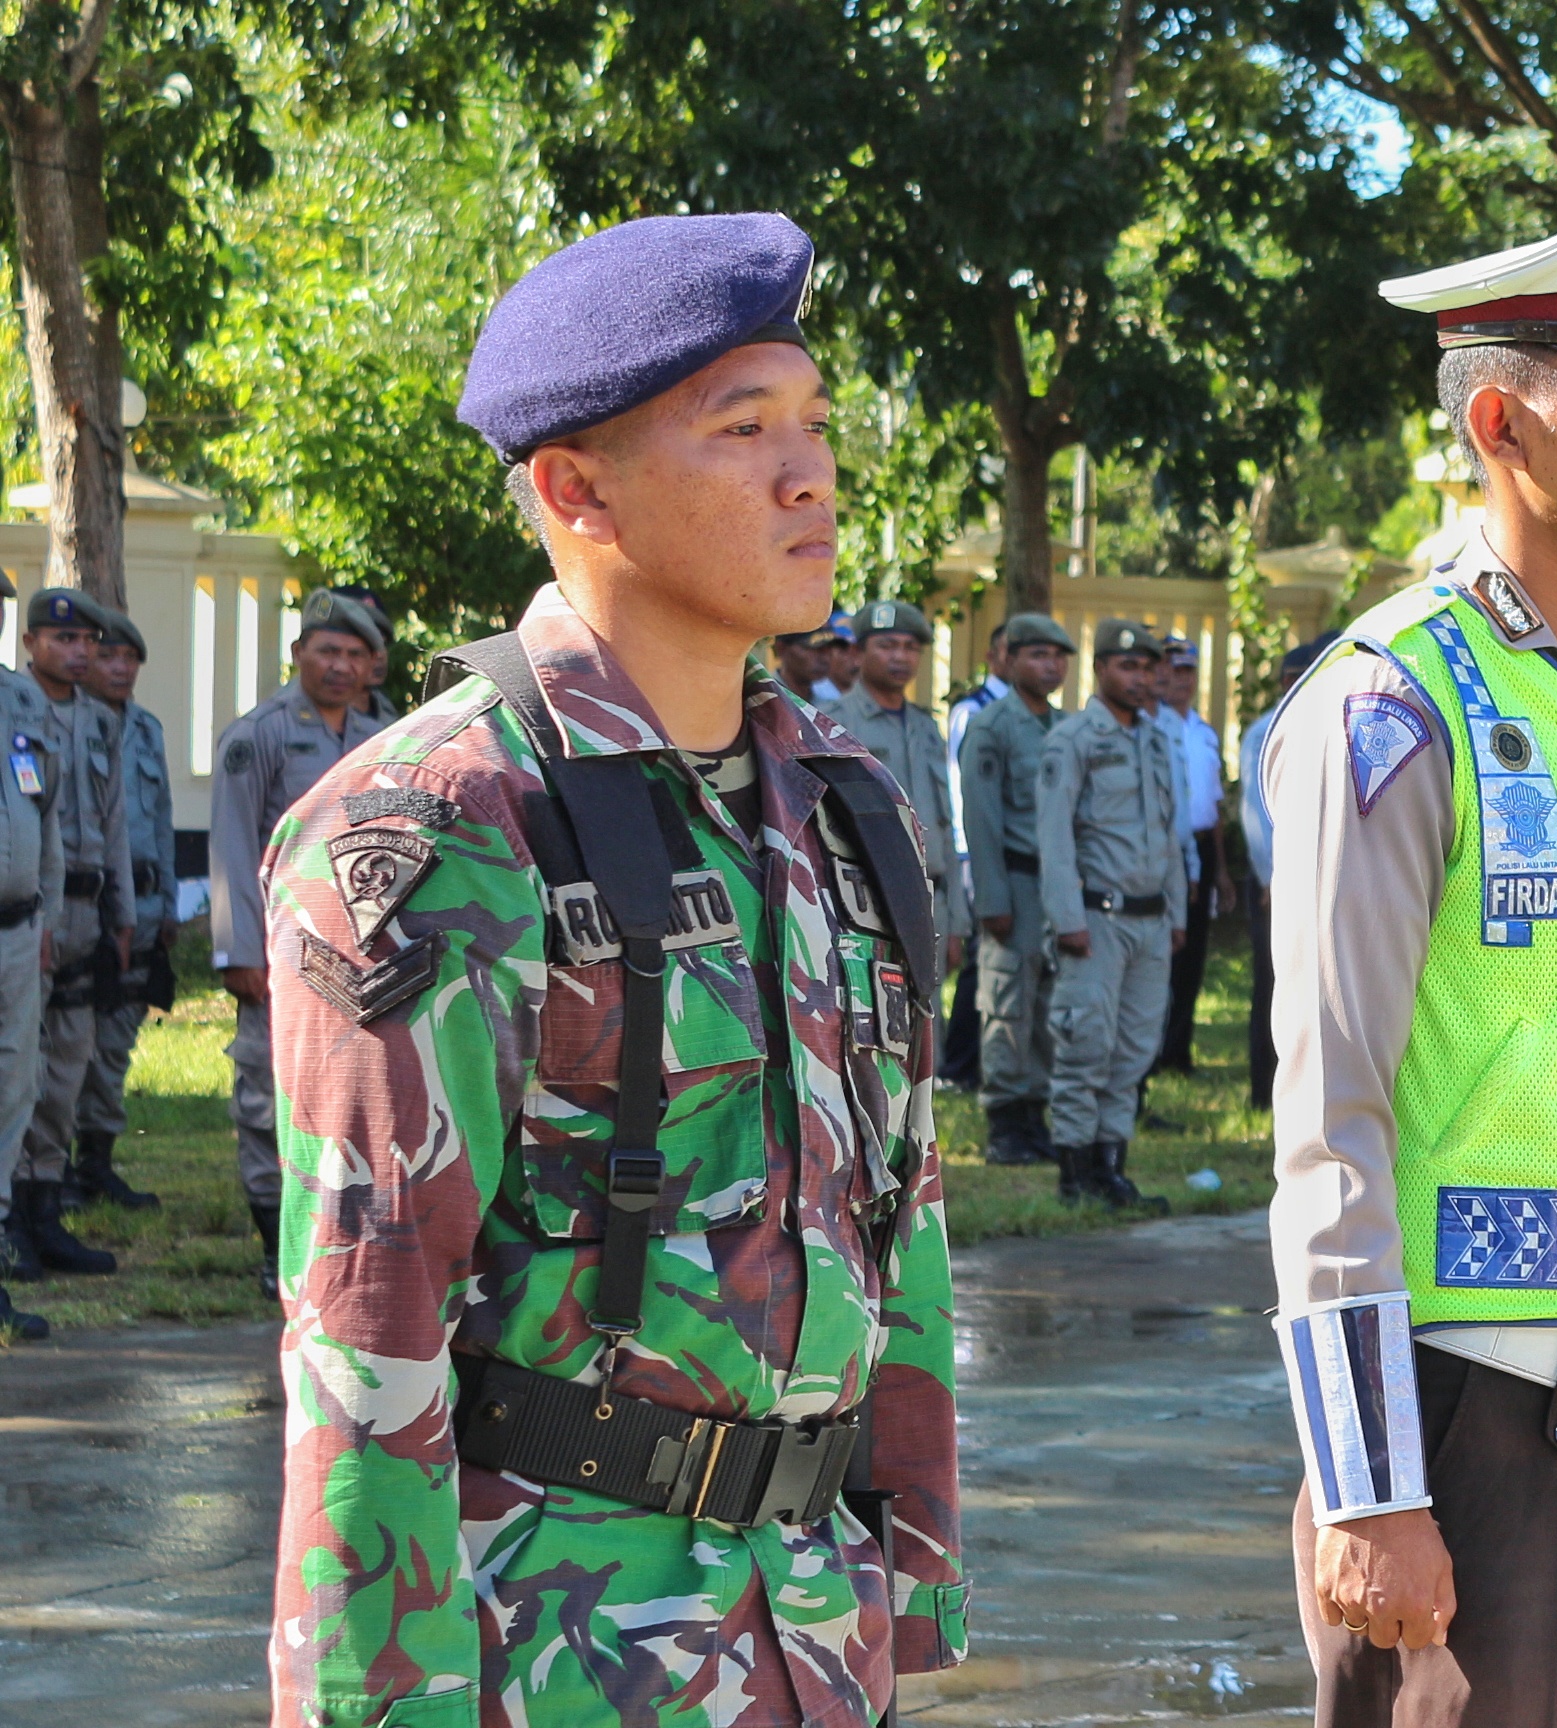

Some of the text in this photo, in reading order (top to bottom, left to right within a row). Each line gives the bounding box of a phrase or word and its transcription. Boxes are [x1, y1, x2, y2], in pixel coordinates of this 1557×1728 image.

[1381, 702, 1402, 717] LALU
[1401, 714, 1423, 739] LINTAS
[1496, 862, 1521, 870] POLISI
[1522, 861, 1539, 869] LALU
